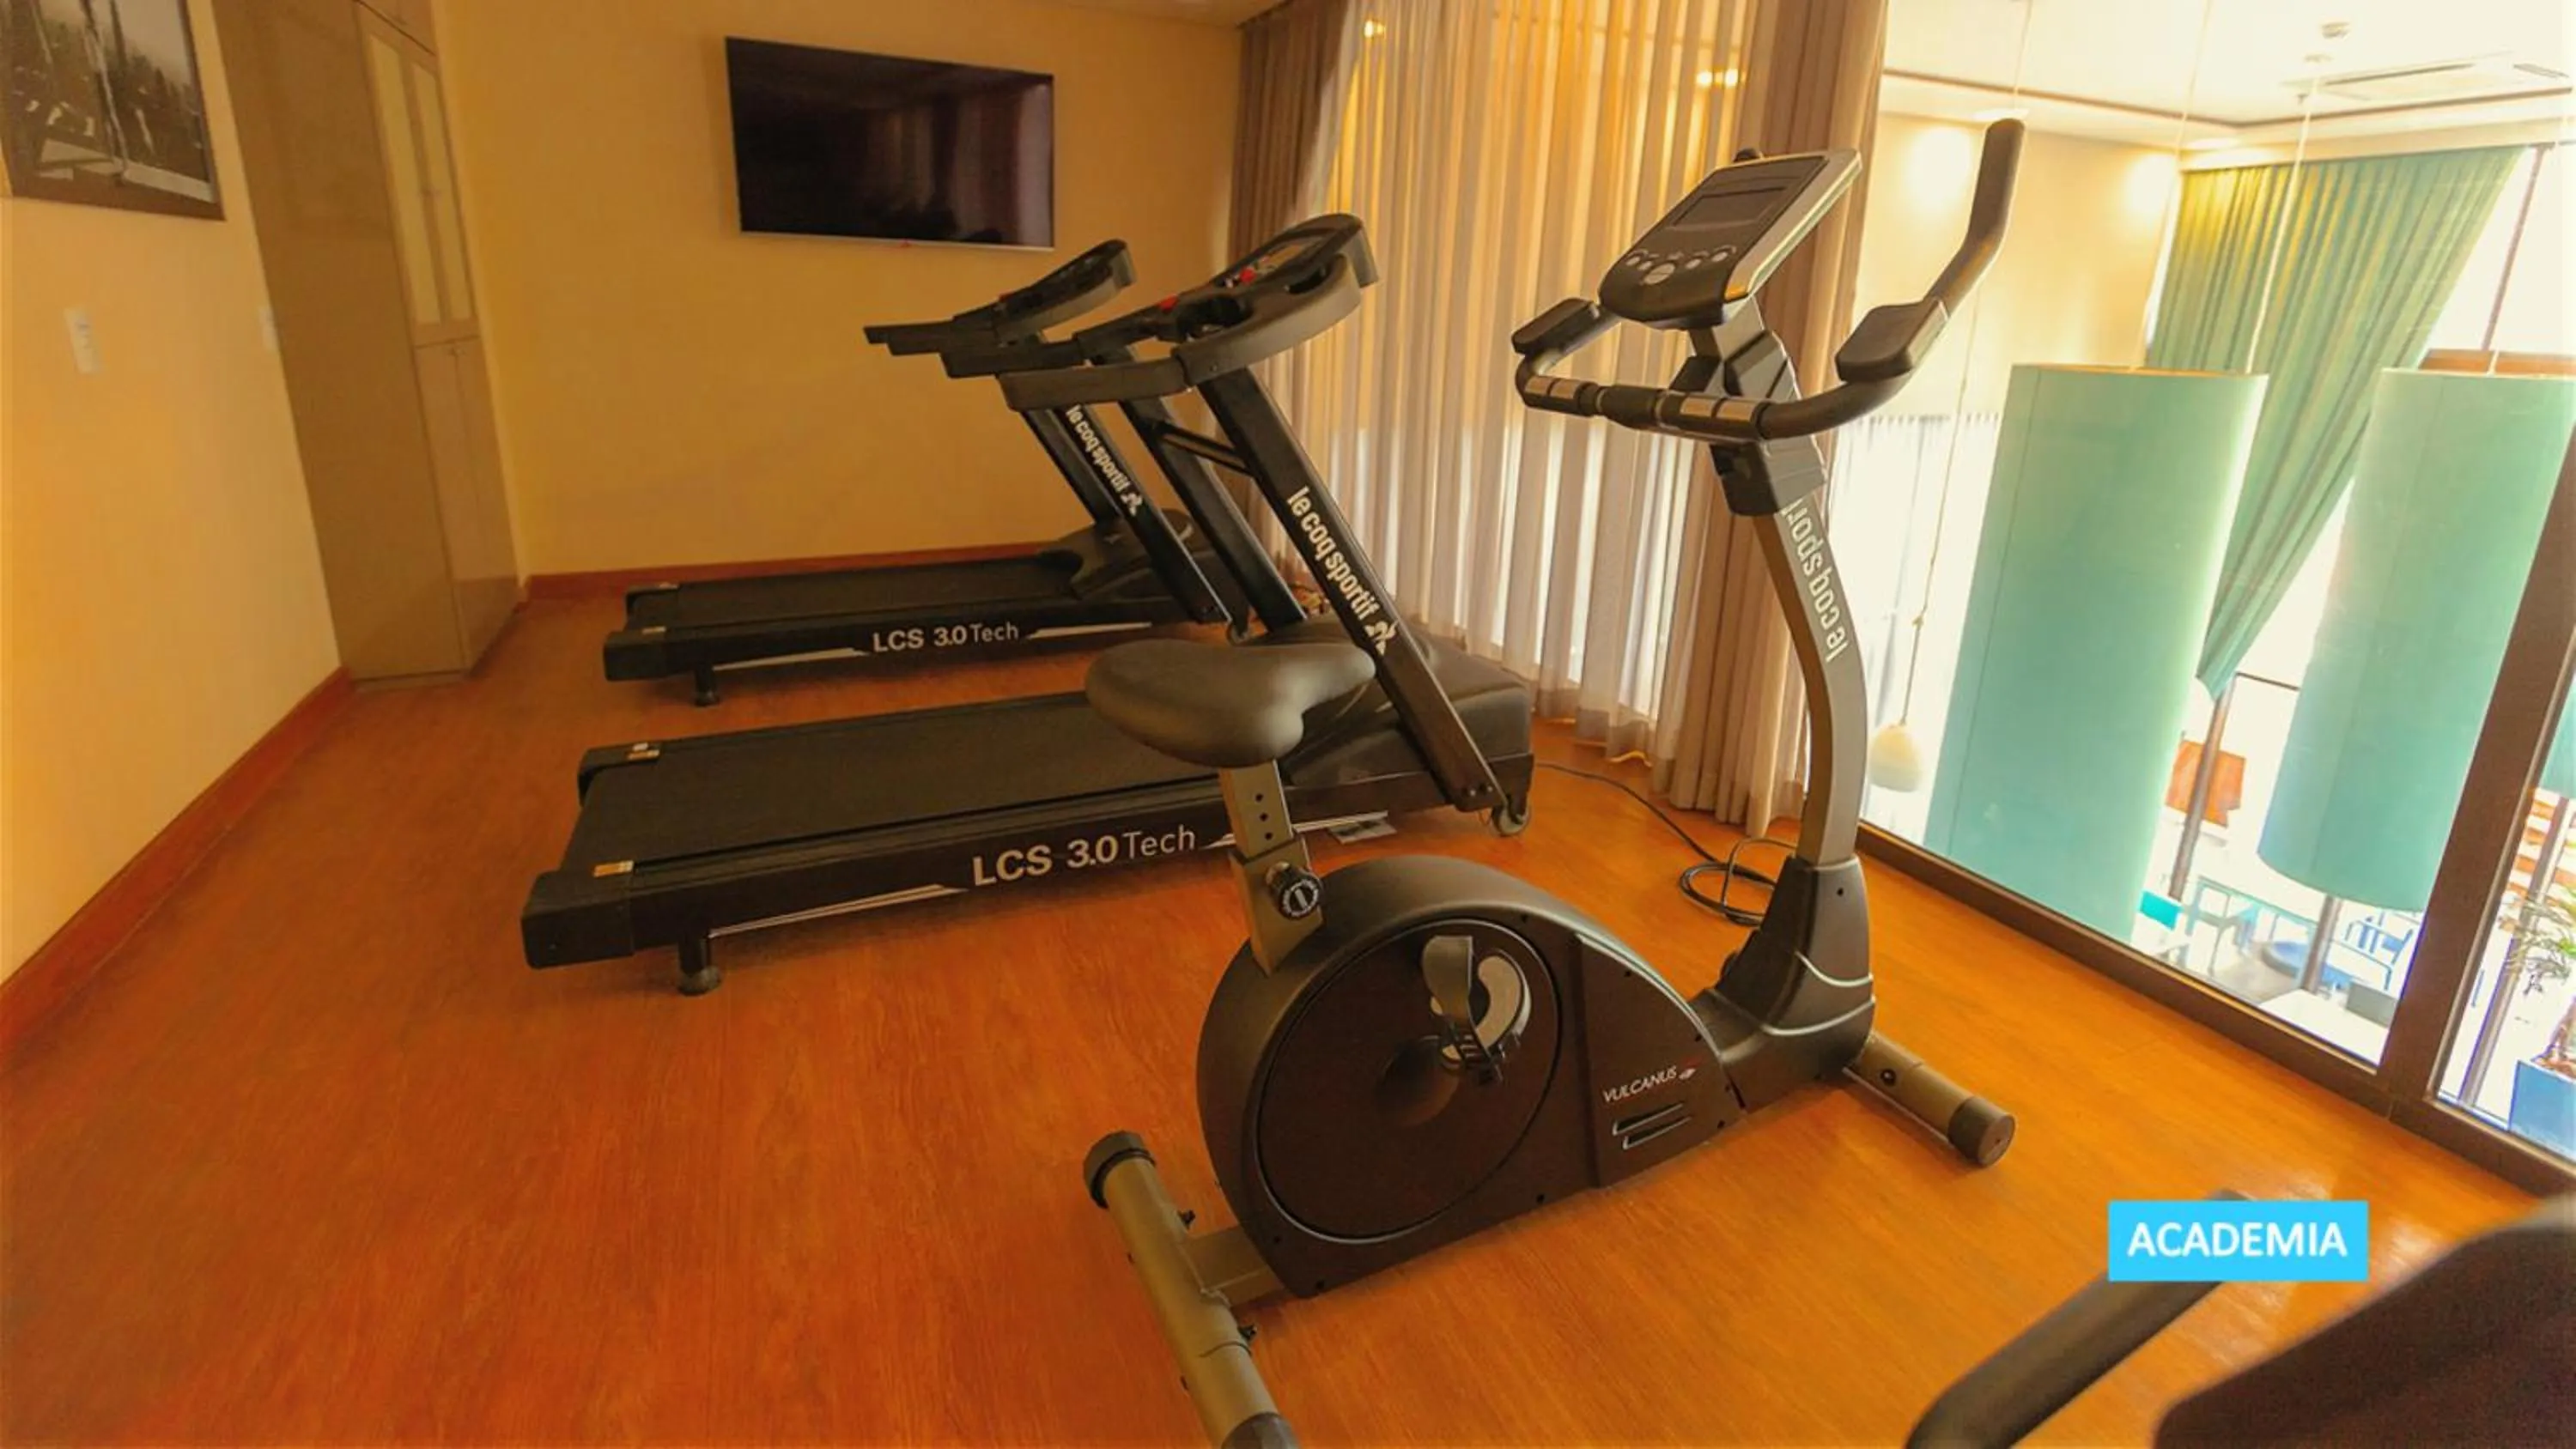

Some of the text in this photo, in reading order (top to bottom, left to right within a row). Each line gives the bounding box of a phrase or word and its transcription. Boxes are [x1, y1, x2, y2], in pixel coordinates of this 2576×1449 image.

[1075, 421, 1100, 452] coq
[1286, 485, 1380, 621] le coq sportif
[1808, 567, 1841, 630] coq
[873, 628, 925, 652] LCS
[1826, 626, 1849, 663] le
[972, 845, 1053, 886] LCS
[1602, 1065, 1677, 1102] VULCANUS
